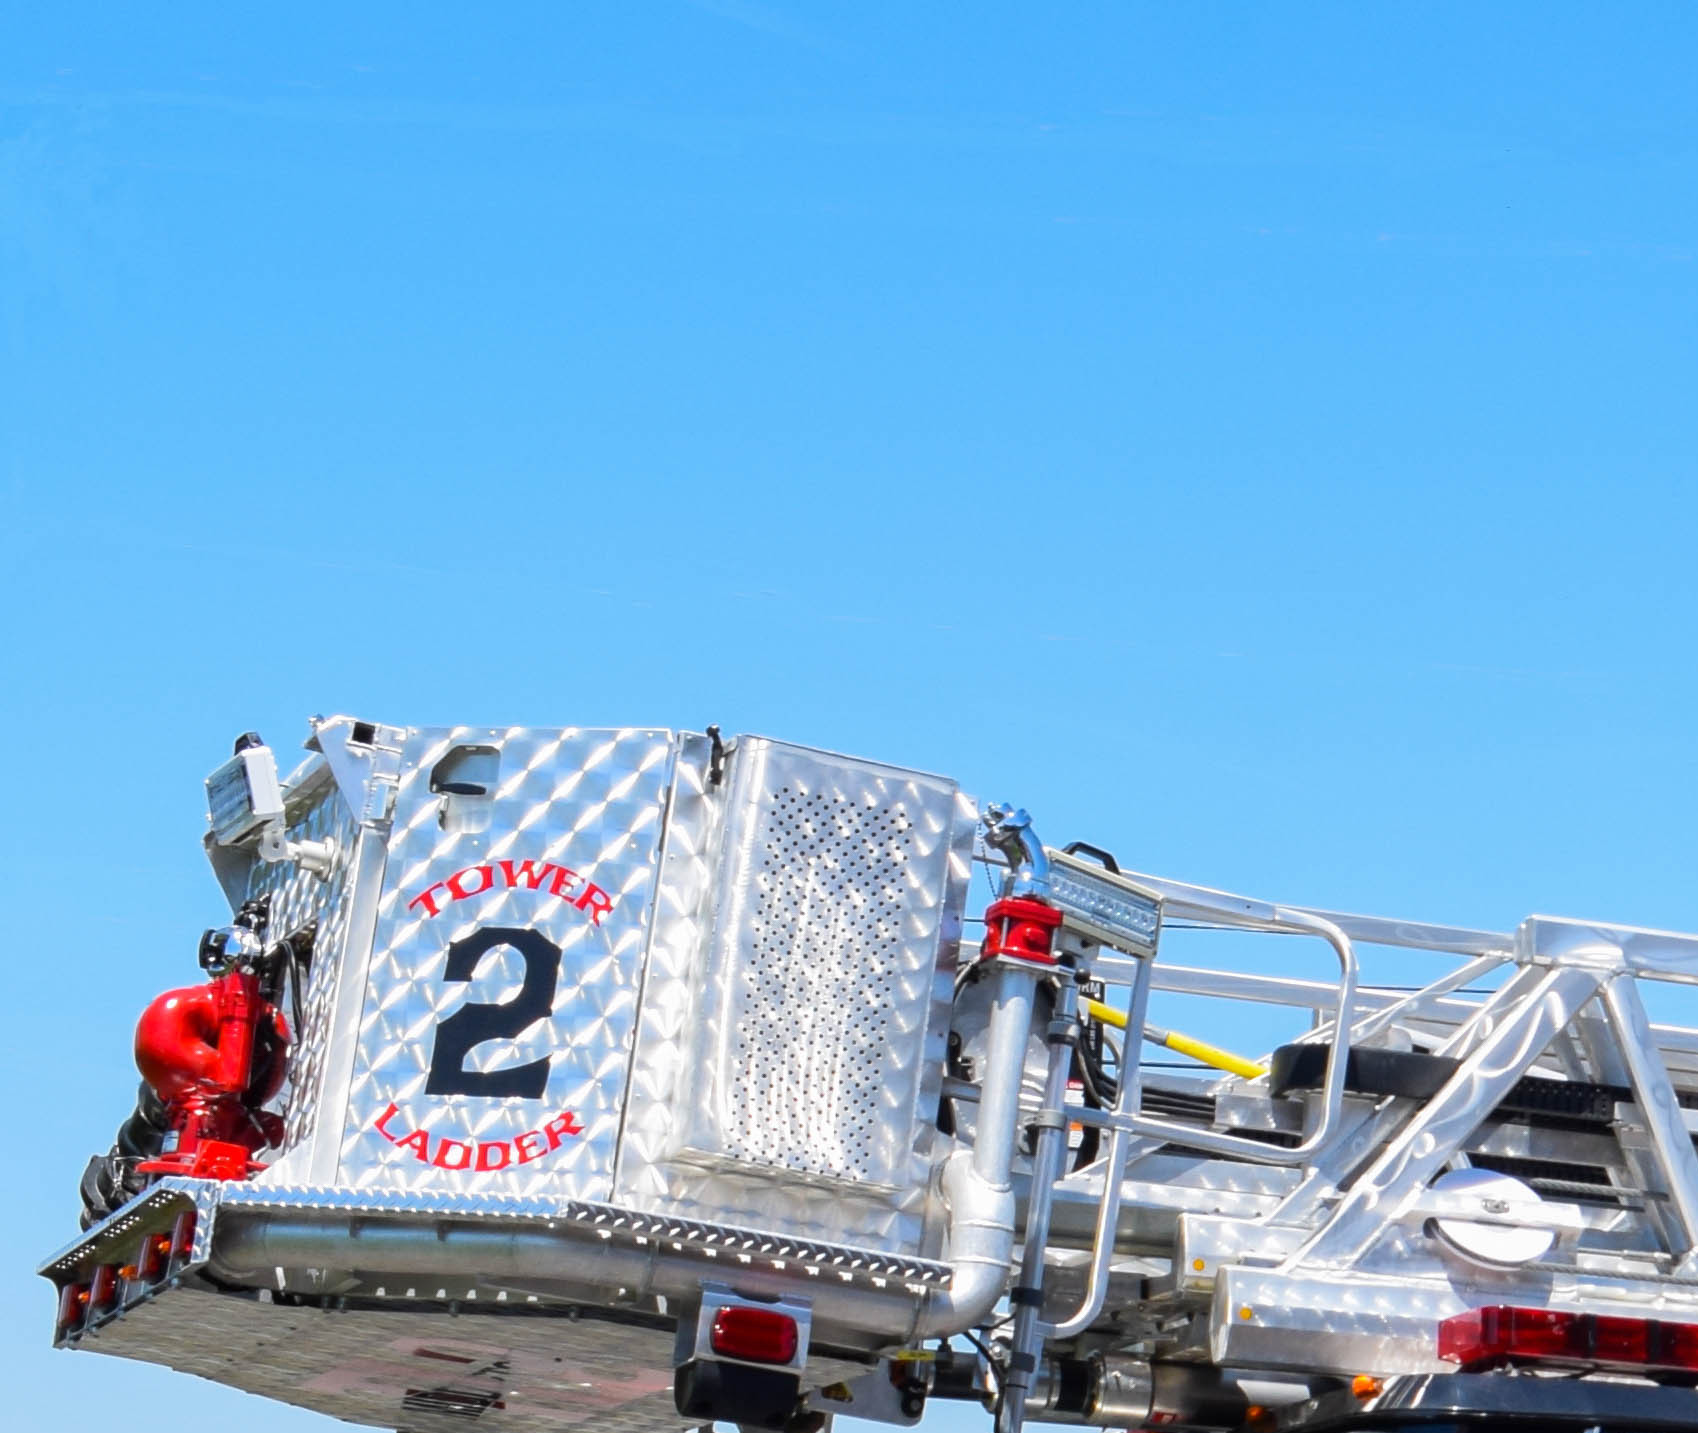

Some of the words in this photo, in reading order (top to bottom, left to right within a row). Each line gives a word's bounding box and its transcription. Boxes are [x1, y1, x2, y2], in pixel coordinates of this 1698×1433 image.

[408, 859, 615, 927] TOWER
[424, 926, 563, 1099] 2
[373, 1101, 586, 1172] LADDER
